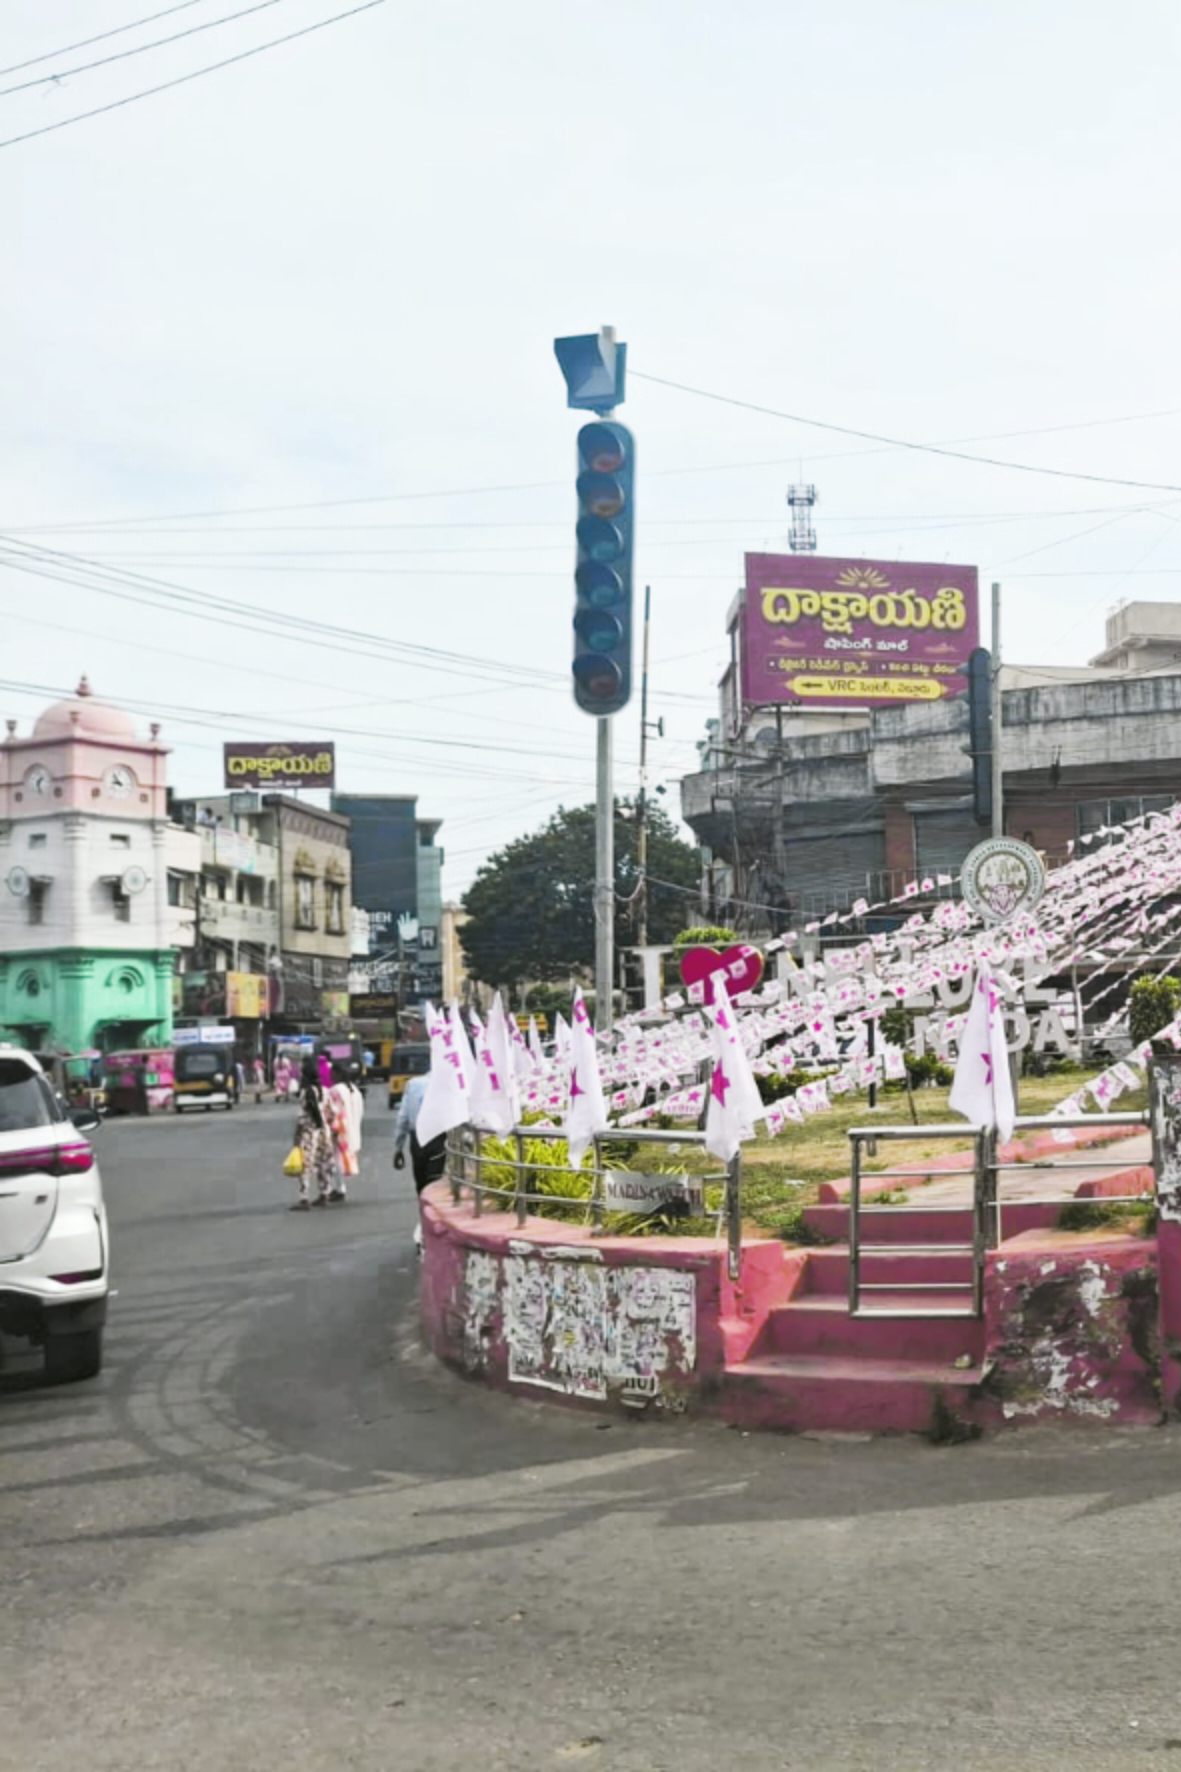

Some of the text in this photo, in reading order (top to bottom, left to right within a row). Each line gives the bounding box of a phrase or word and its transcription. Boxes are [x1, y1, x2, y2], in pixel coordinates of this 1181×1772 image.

[760, 586, 967, 635] దాక్షాయణి
[827, 679, 857, 692] VRC
[227, 751, 332, 779] దాక్షాయణి
[912, 1010, 1070, 1059] NDA
